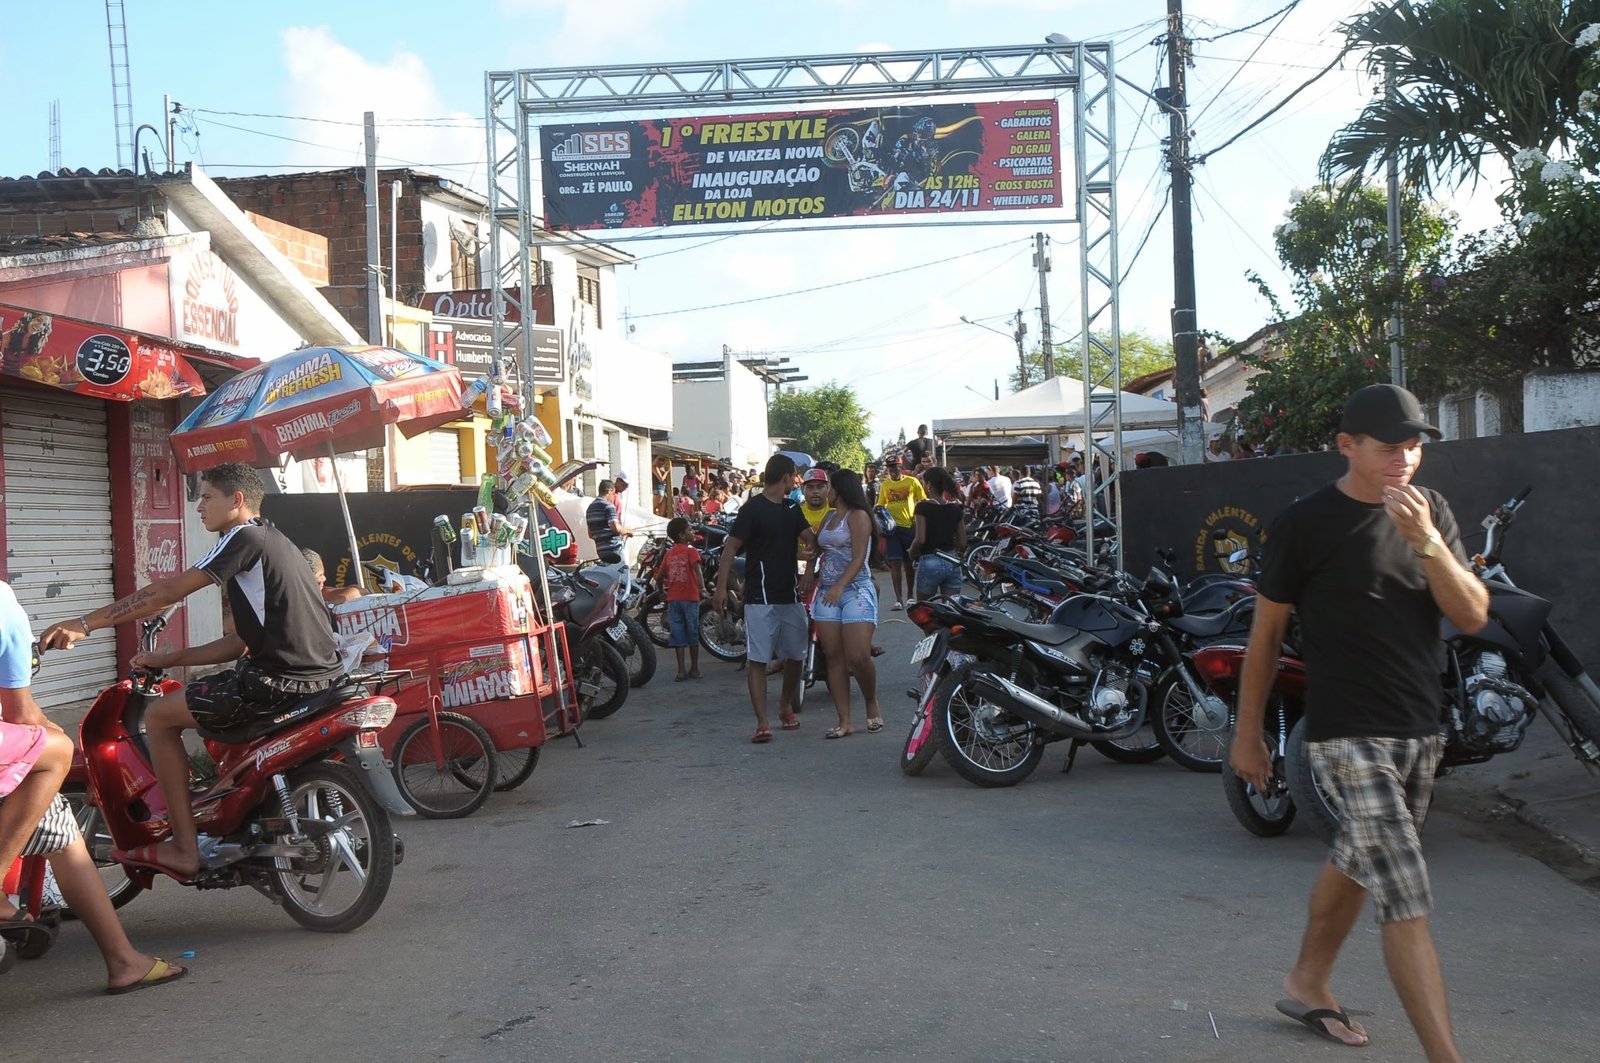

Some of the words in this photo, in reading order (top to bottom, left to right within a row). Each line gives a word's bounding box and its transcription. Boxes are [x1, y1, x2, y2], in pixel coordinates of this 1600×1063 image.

[1000, 116, 1053, 128] GABARITOS
[699, 117, 828, 145] FREESTYLE
[1016, 130, 1051, 140] GALERA
[584, 133, 629, 153] SCS
[1010, 145, 1023, 155] DO
[1025, 143, 1052, 154] GRAU
[706, 151, 723, 165] DE
[728, 148, 781, 164] VARZEA
[784, 146, 825, 161] NOVA
[999, 156, 1053, 168] PSICOPATAS
[564, 161, 620, 172] SHEKNAH
[1012, 166, 1053, 176] WHEELING
[691, 164, 821, 188] INAUGURAÇÃO
[559, 186, 580, 195] ORG.:
[582, 179, 596, 194] ZÉ
[597, 180, 633, 193] PAULO
[994, 180, 1023, 191] CROSS
[1024, 179, 1054, 190] BOSTA
[704, 188, 722, 201] DA
[724, 187, 753, 199] LOJA
[895, 190, 926, 209] DIA
[929, 189, 981, 209] 24/11
[993, 195, 1039, 206] WHEELING
[1040, 194, 1054, 204] PB
[672, 202, 746, 222] ELLTON
[751, 197, 825, 218] MOTOS
[183, 298, 240, 347] ESSENCIAL
[456, 331, 492, 343] Advocacia
[85, 348, 131, 374] 3,50
[456, 350, 493, 364] Humberto
[275, 352, 333, 389] BRAHMA
[280, 362, 342, 399] REFRESH
[275, 411, 329, 444] BRAHMA
[186, 448, 194, 458] A
[192, 443, 218, 457] BRAHMA
[1205, 506, 1258, 527] VALENTES
[335, 557, 351, 588] ANDA
[348, 532, 402, 553] ALENTES
[402, 545, 416, 562] DE
